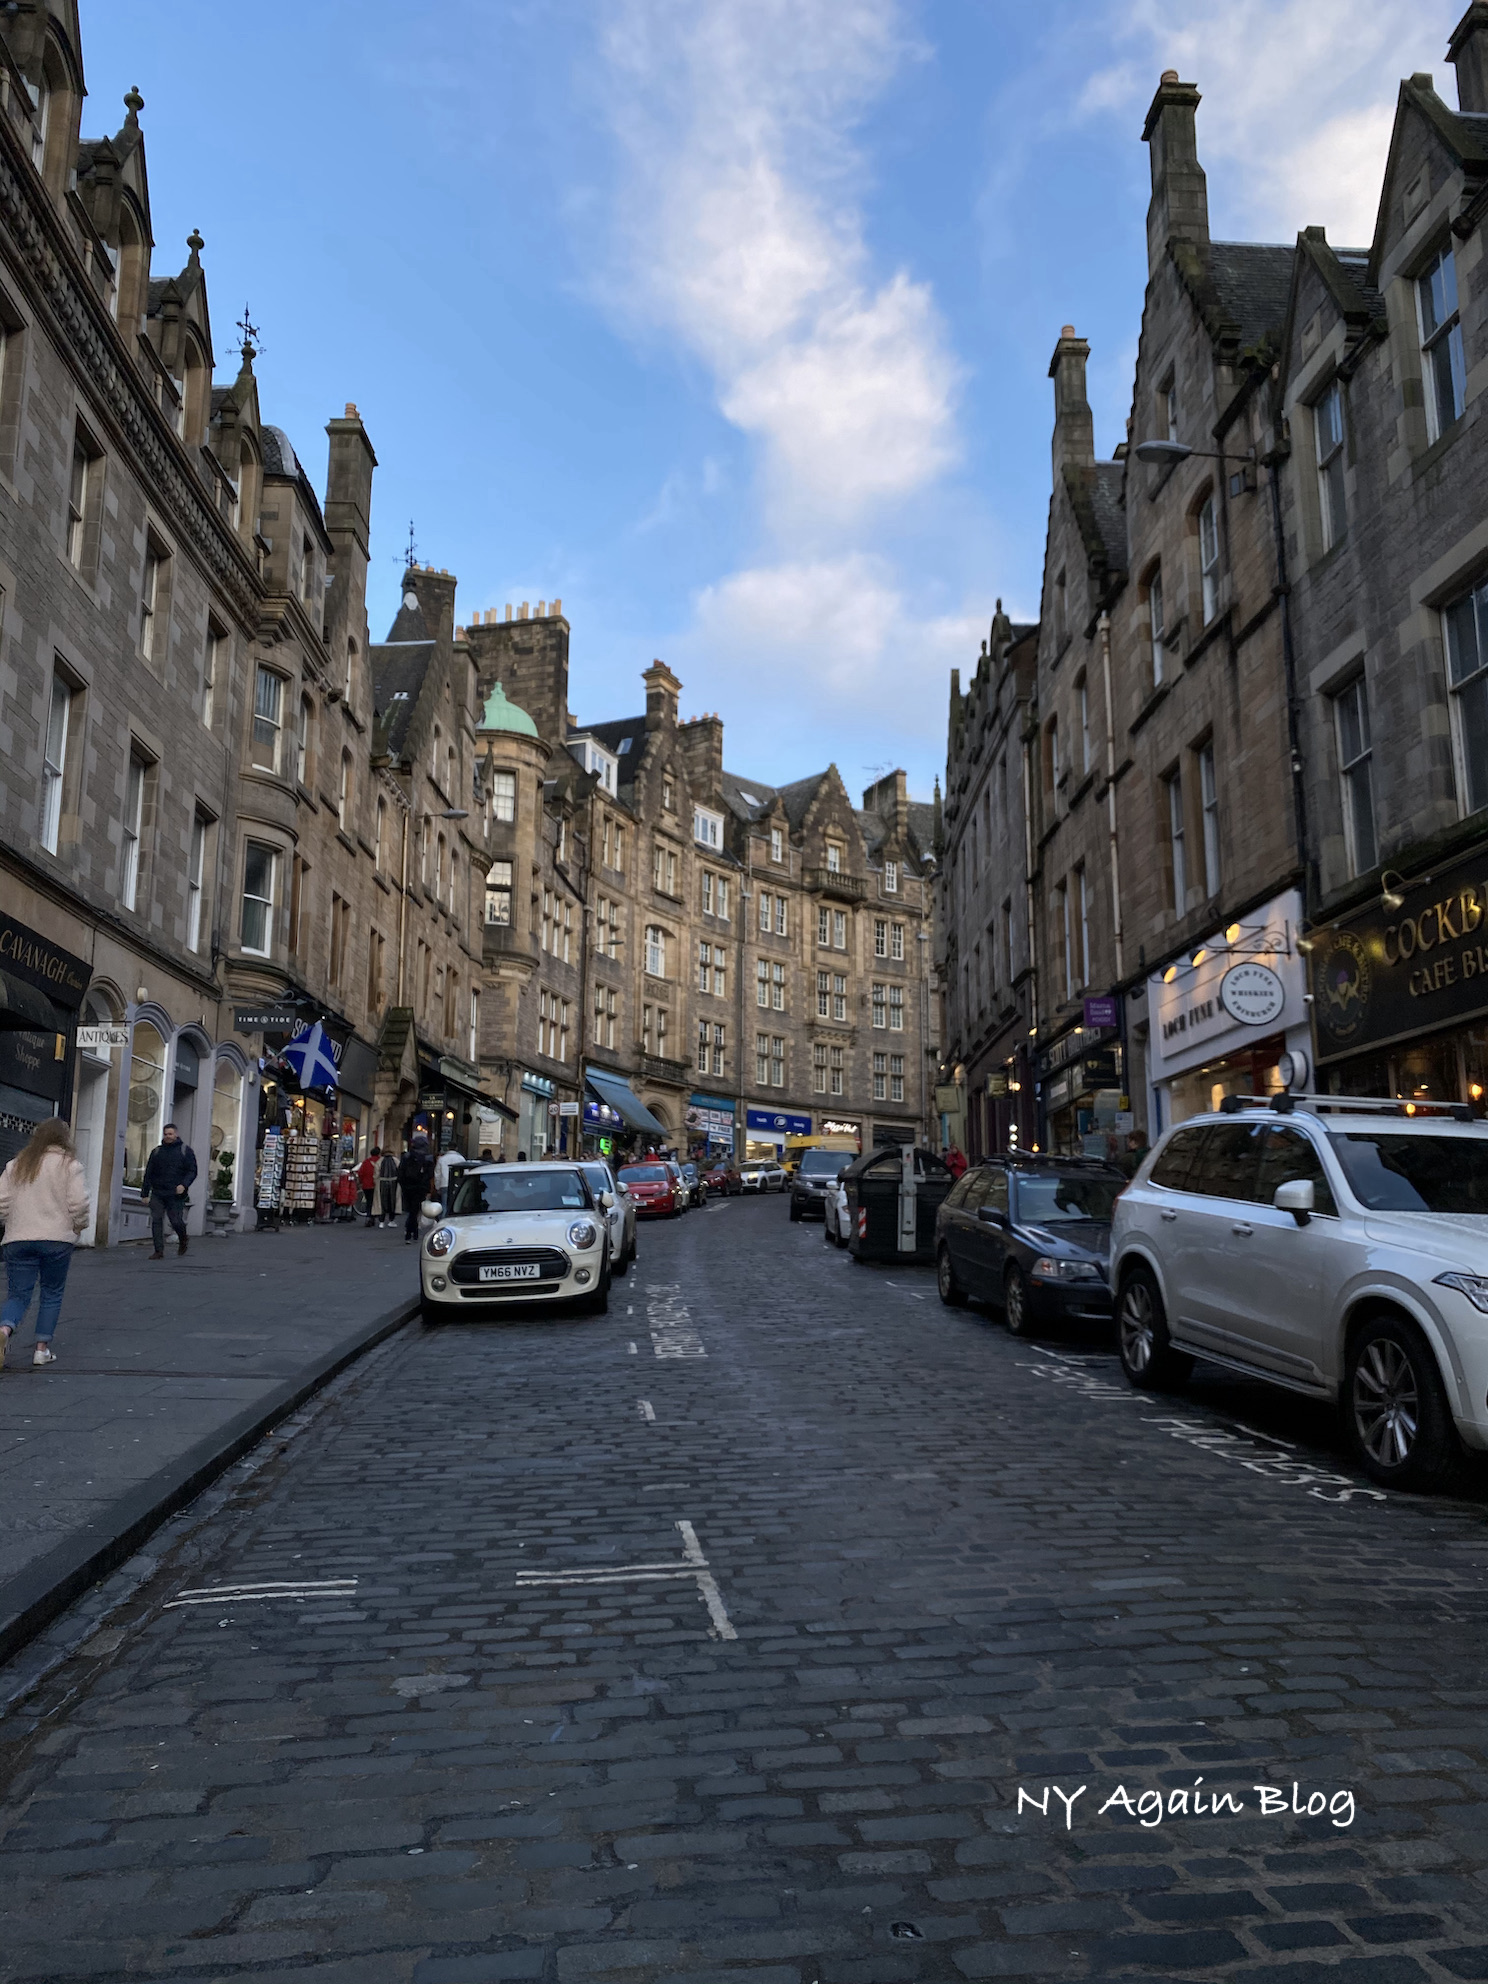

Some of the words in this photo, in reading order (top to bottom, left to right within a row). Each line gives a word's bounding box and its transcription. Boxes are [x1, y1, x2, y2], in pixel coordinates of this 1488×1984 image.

[1384, 881, 1488, 967] COCKB
[0, 929, 68, 984] CAVANAGH
[1231, 970, 1251, 986] LOCH
[1252, 970, 1273, 986] FYNE
[1409, 956, 1459, 997] CAFE
[1462, 945, 1488, 979] BI
[1230, 989, 1275, 997] WHISKIES
[1163, 1013, 1186, 1040] LOCH
[1188, 1000, 1213, 1027] FYNE
[1232, 1001, 1276, 1017] EDINBURGH
[79, 1027, 129, 1044] ANTIQUES
[483, 1267, 511, 1279] YM66
[514, 1265, 535, 1277] NVZ
[1139, 1416, 1388, 1501] HOLDERS
